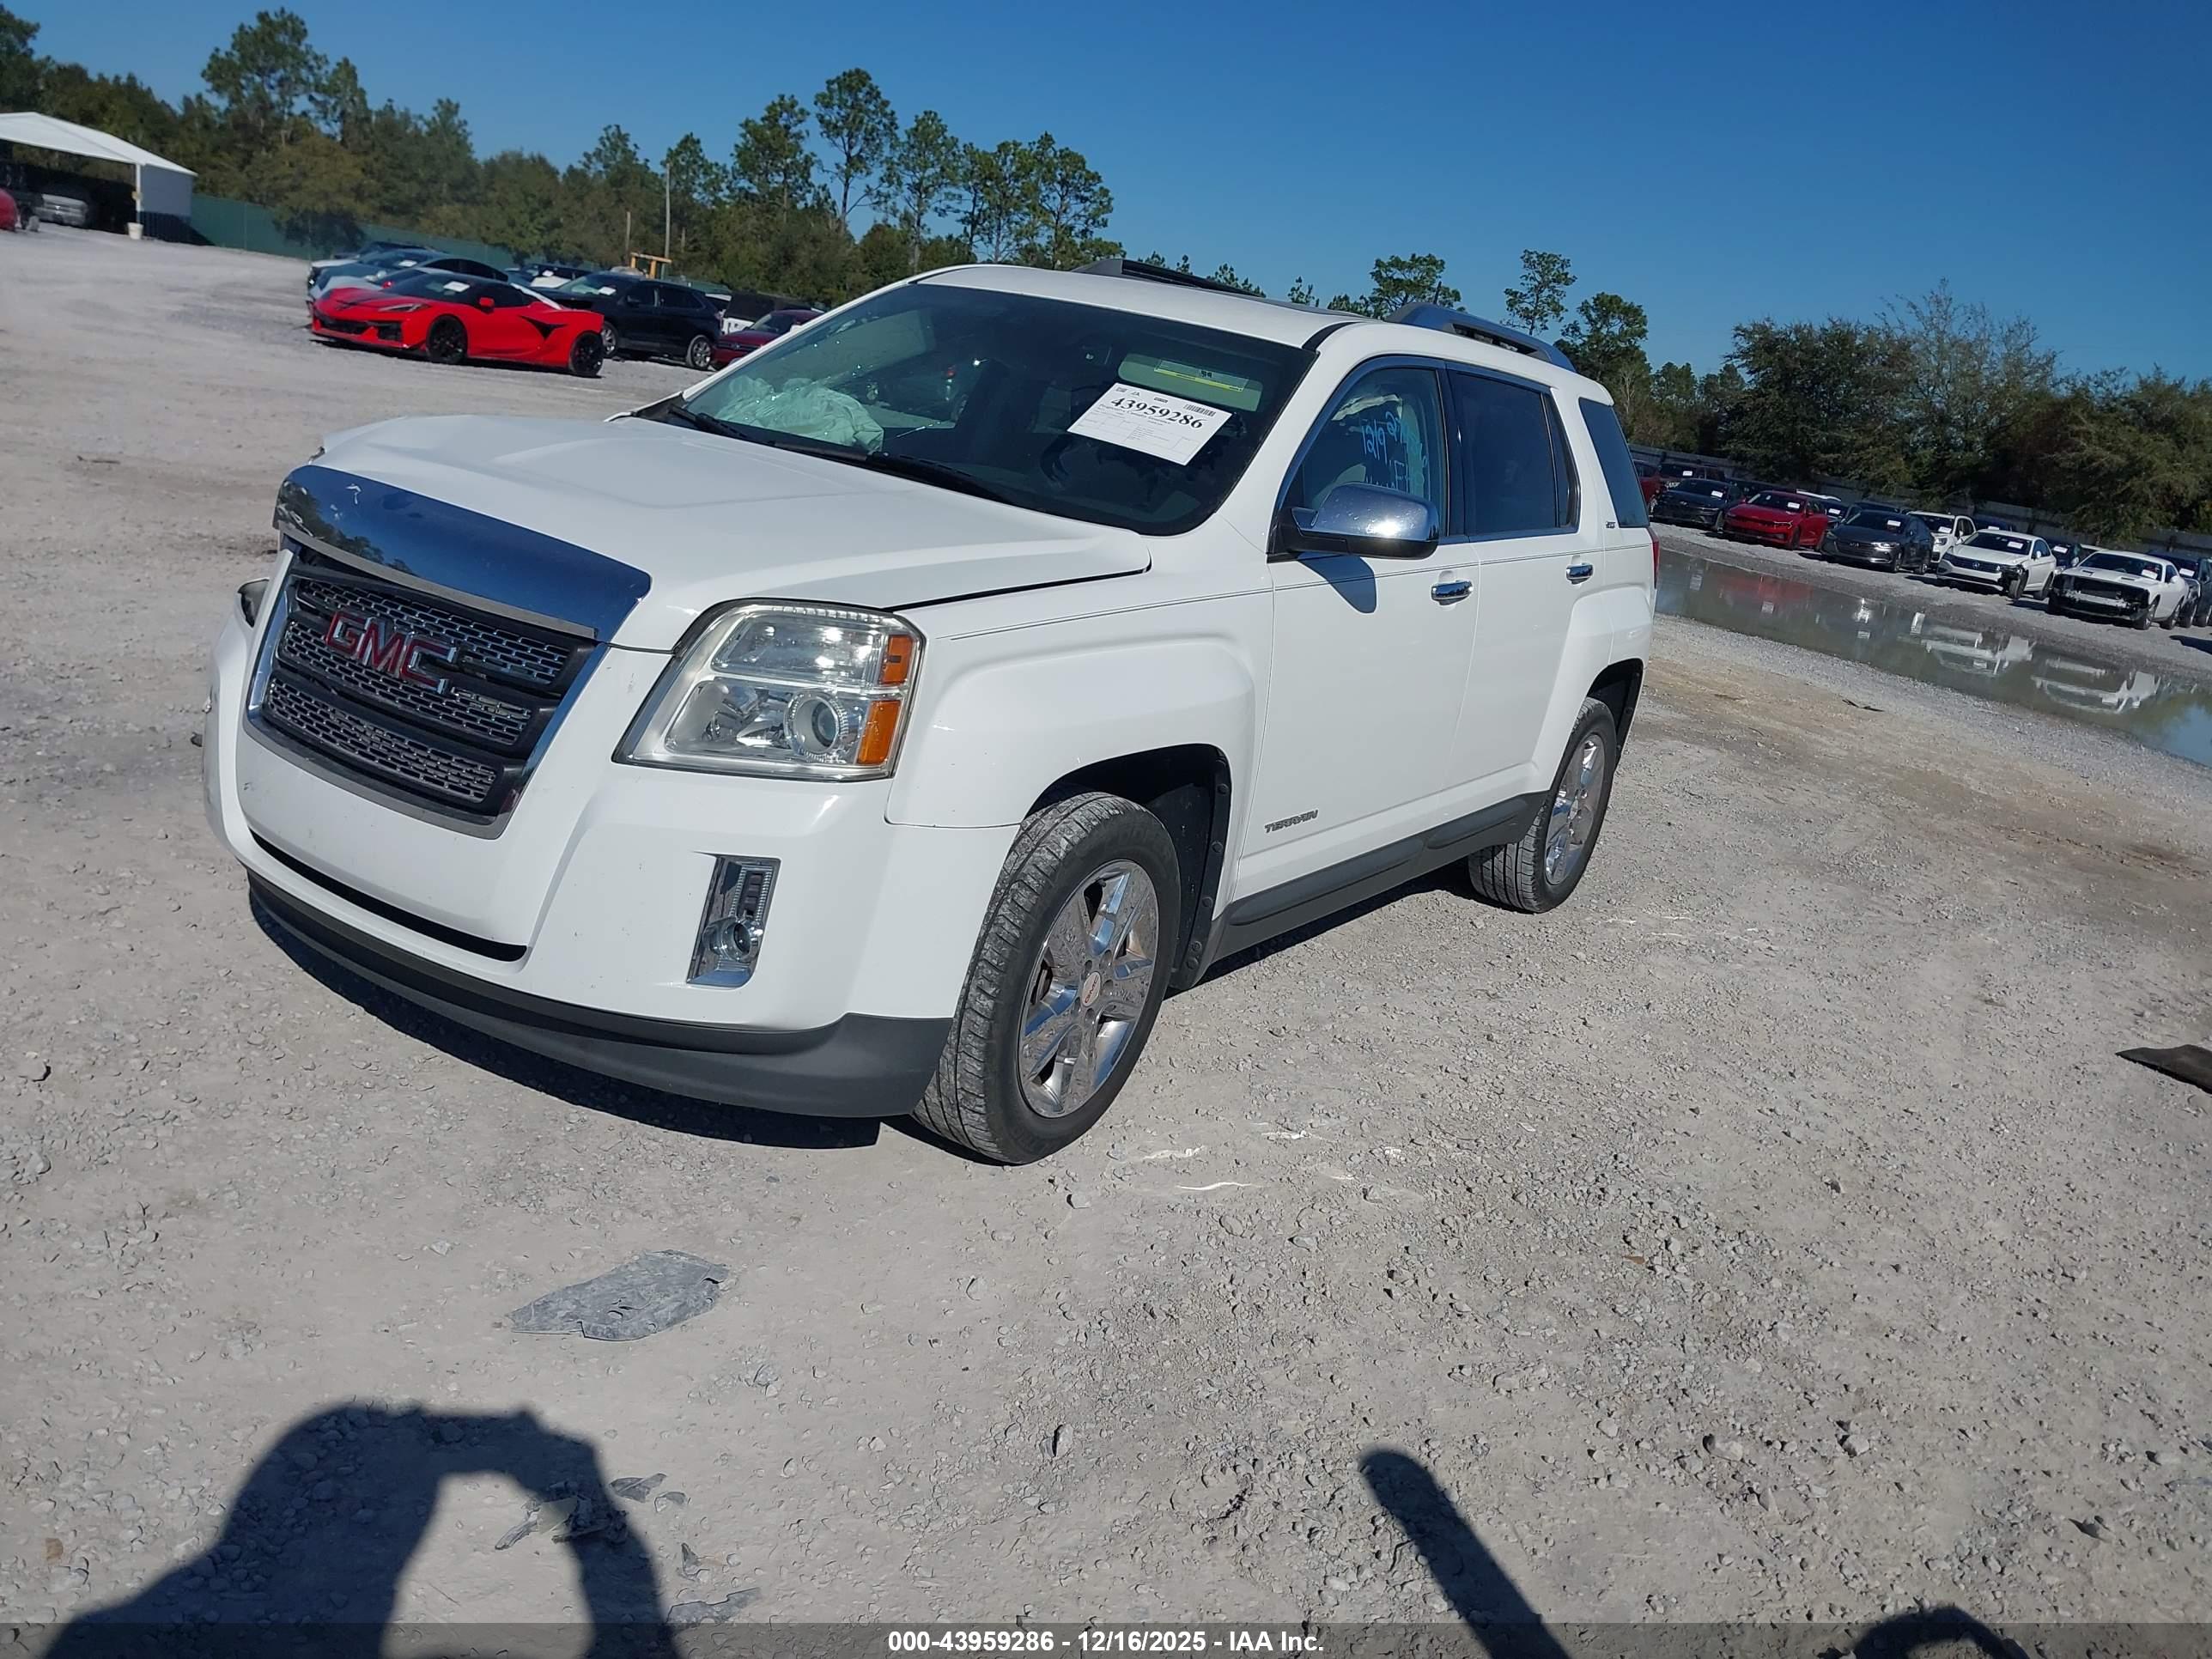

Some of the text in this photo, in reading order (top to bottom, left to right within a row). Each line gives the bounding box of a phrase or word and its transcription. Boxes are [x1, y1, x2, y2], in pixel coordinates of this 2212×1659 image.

[1111, 397, 1206, 428] 43959286
[325, 611, 457, 695] GMC
[1264, 809, 1318, 833] TERRAIN
[1085, 975, 1099, 1004] GMC
